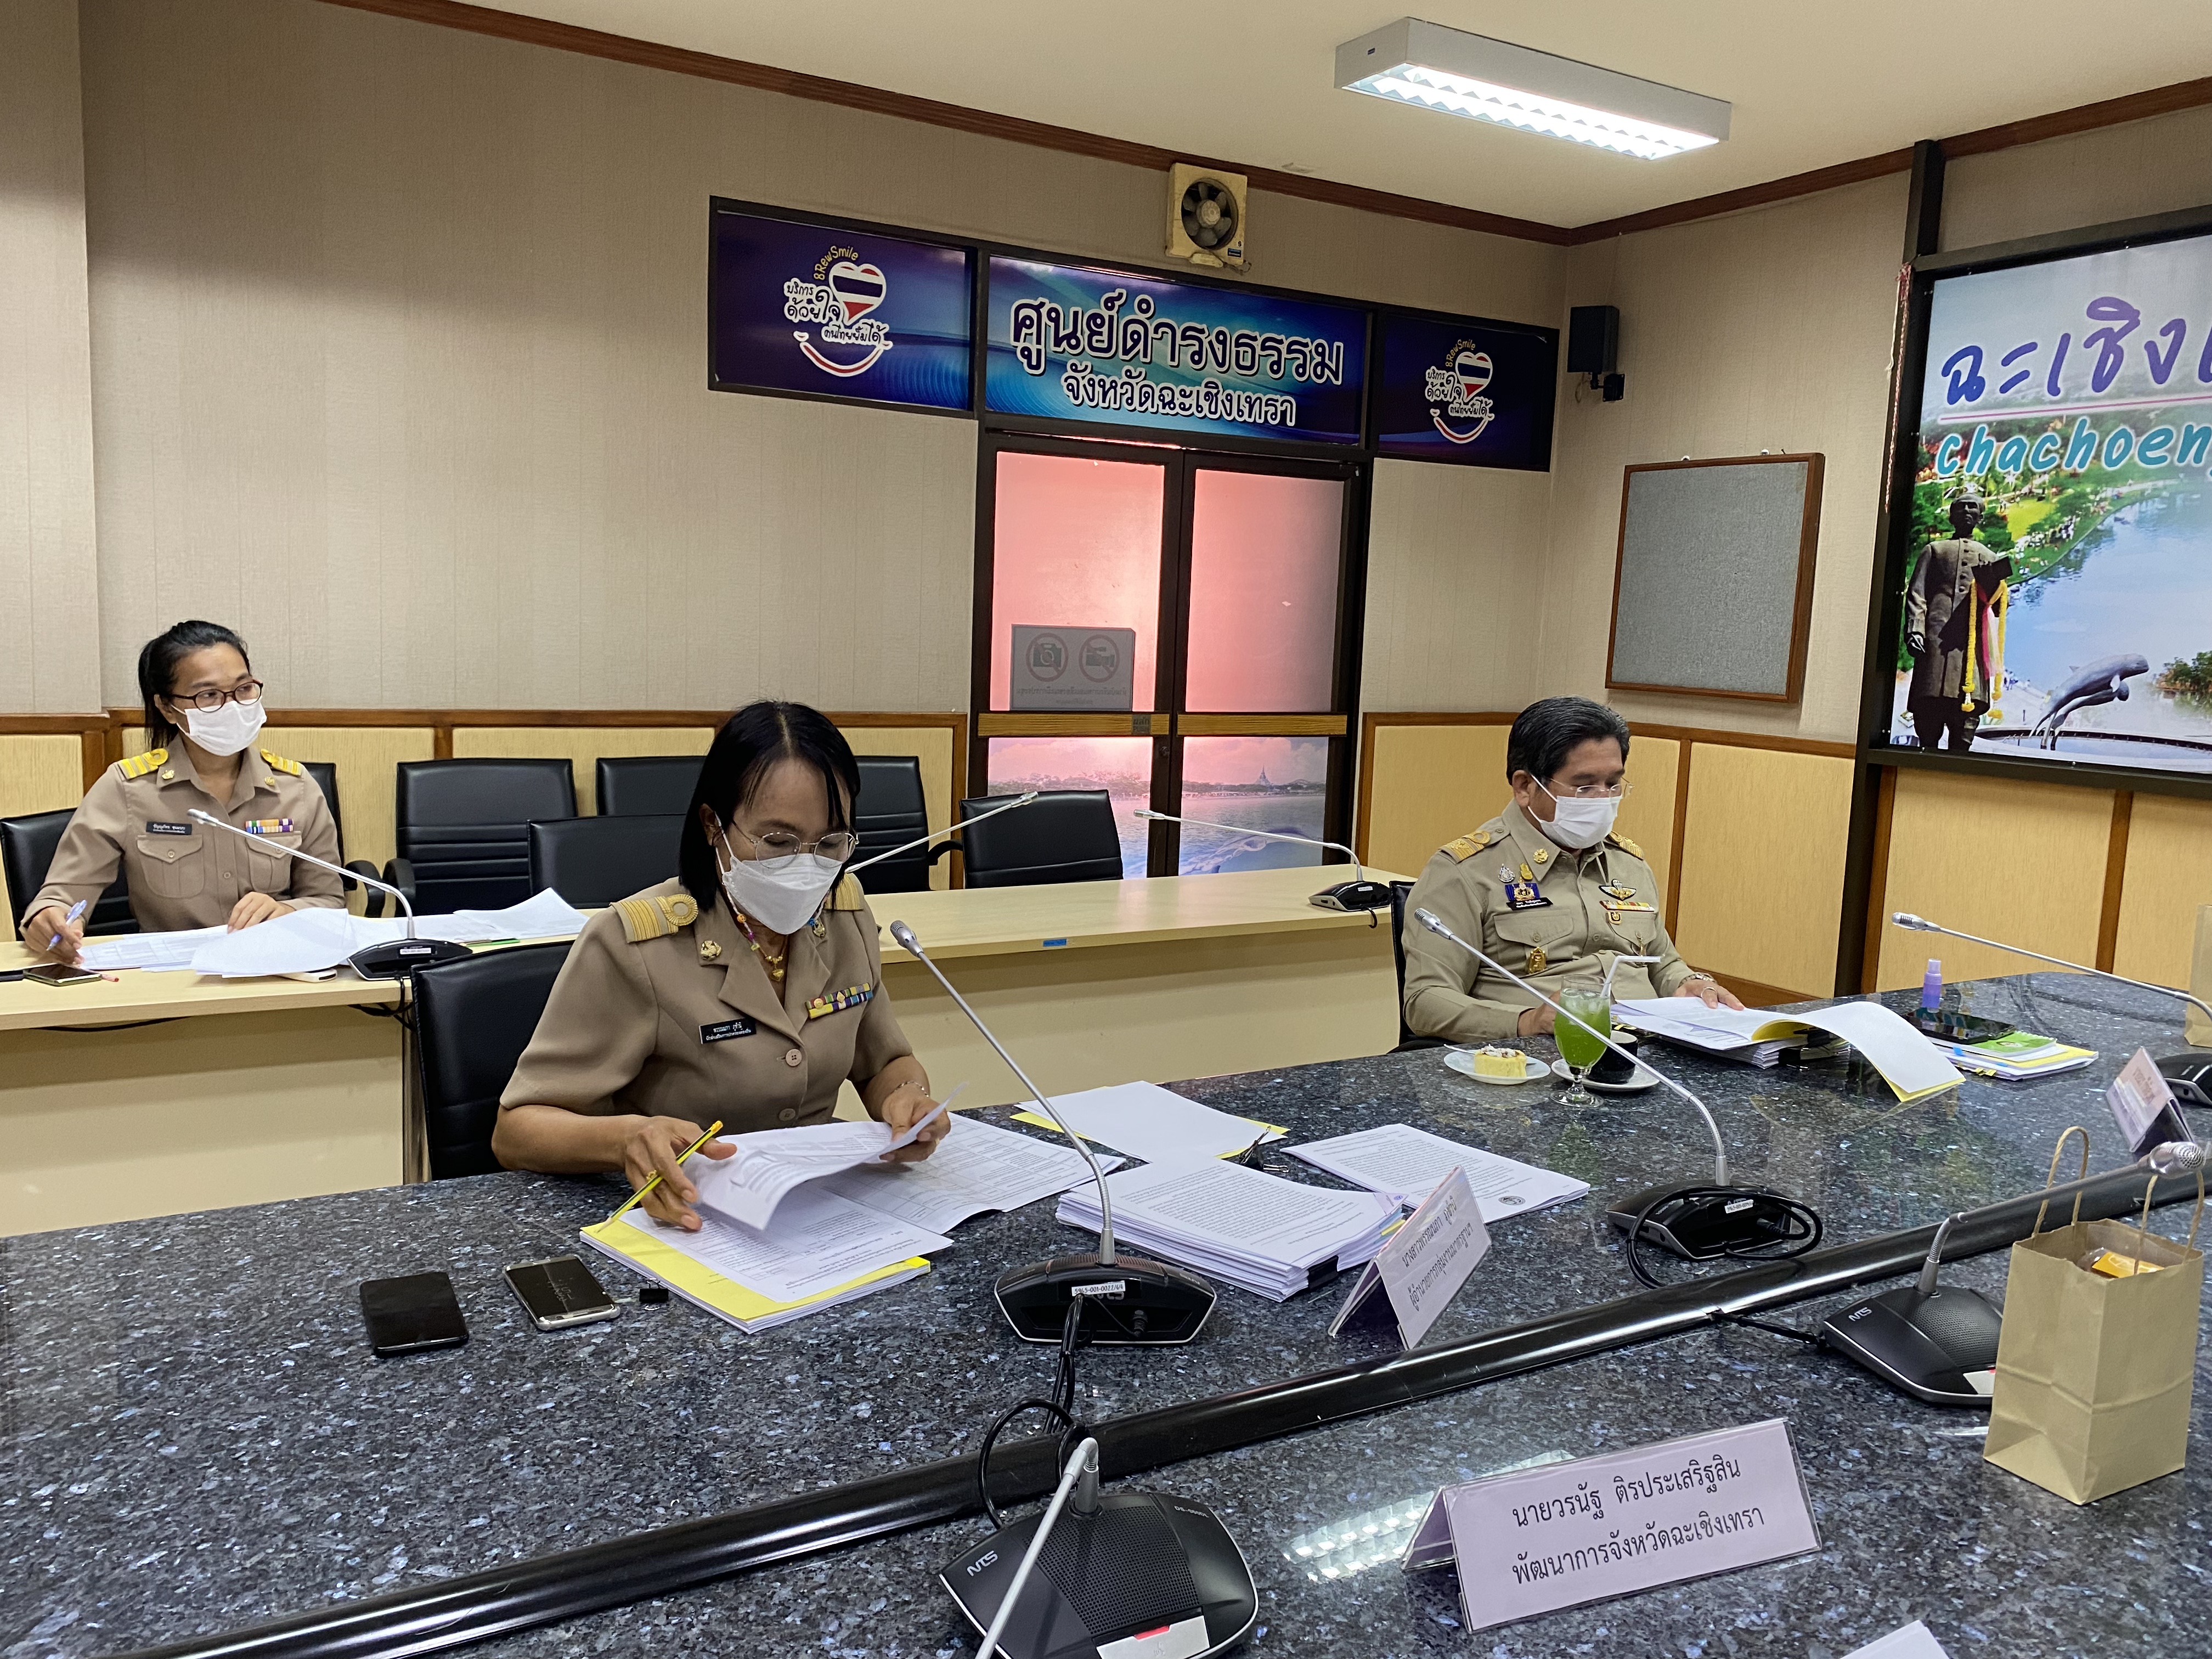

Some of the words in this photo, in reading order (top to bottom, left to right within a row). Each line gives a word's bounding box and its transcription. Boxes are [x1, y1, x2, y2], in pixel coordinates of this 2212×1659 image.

[787, 281, 814, 296] บริการ
[787, 289, 840, 322] ด้วยใจ
[823, 322, 887, 345] คนไทยยิ้มได้
[1011, 290, 1343, 383] ศูนย์ดำรงธรรม
[1427, 369, 1445, 380] บริการ
[1427, 374, 1462, 400] ด้วยใจ
[1063, 362, 1295, 425] จังหวัดฉะเชิงเทรา
[1936, 418, 2212, 477] chachoen
[1848, 1307, 1872, 1321] NTS
[1513, 1482, 1604, 1527] นายวรนัฐ
[1613, 1454, 1741, 1504] ติรประเสริฐสิน
[1512, 1506, 1765, 1584] พัฒนาการจังหวัดฉะเชิงเทรา
[967, 1550, 998, 1576] NTS
